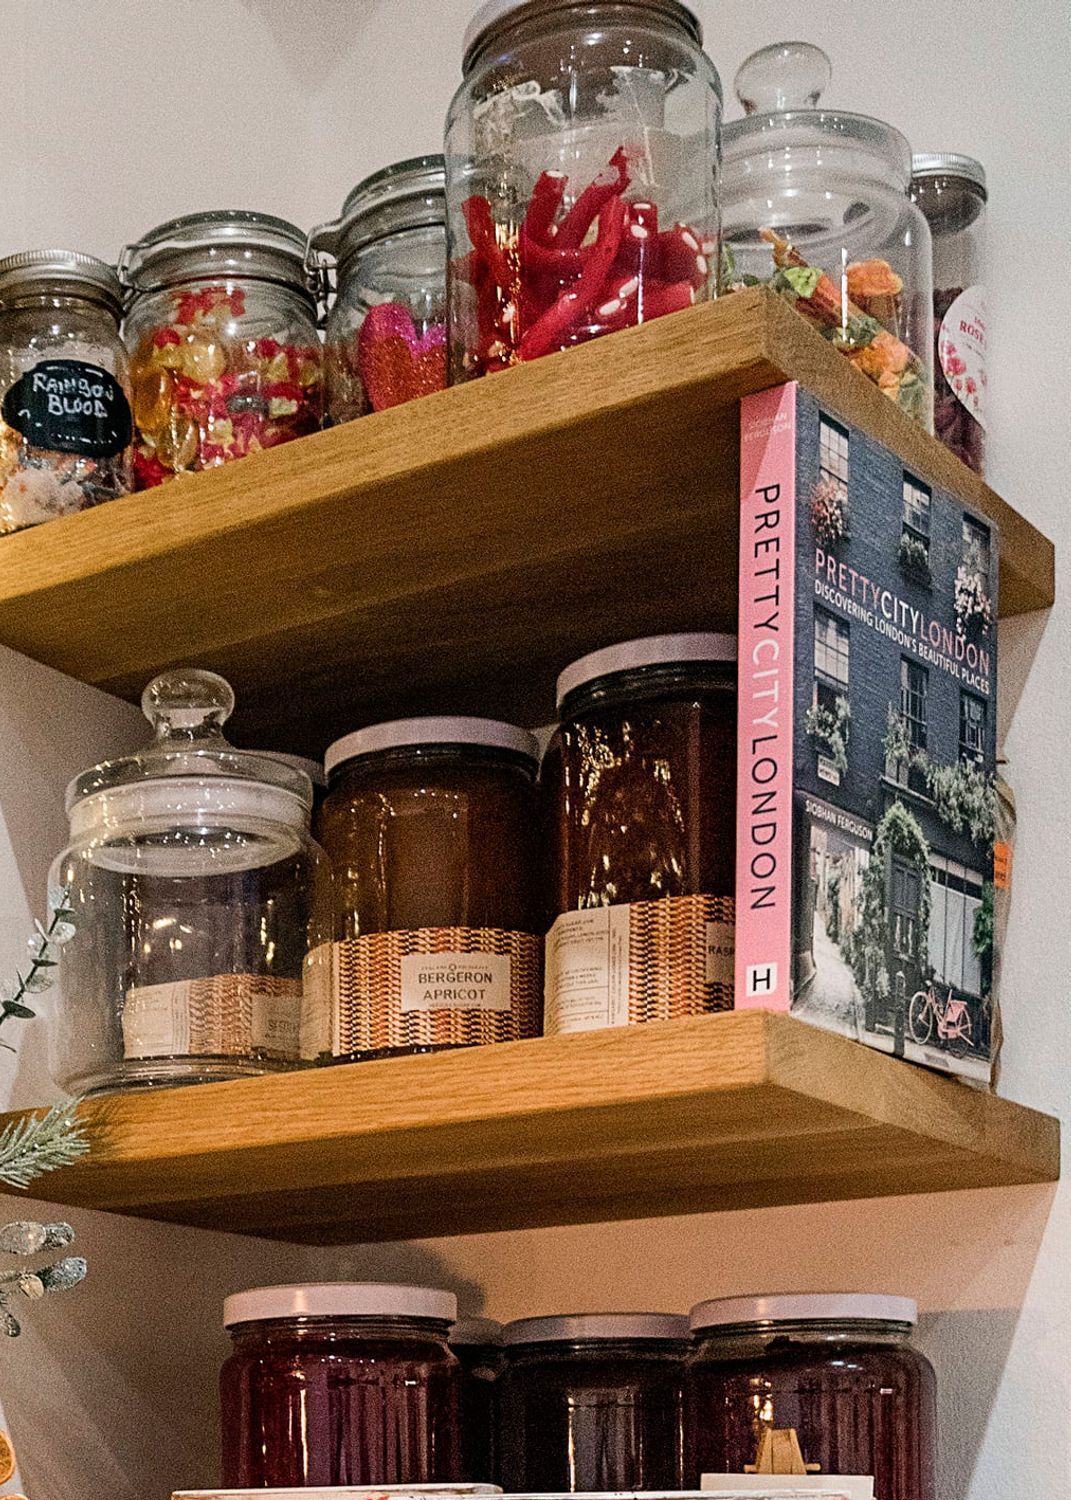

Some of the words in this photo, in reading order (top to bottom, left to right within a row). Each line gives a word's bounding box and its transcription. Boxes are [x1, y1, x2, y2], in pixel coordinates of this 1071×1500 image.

[814, 579, 873, 627] DISCOVERING
[874, 610, 917, 653] LONDON'S
[918, 642, 961, 678] BEAUTIFUL
[961, 667, 990, 695] PLACES
[418, 972, 493, 984] BERGERON
[752, 968, 771, 992] H
[423, 989, 486, 1001] APRICOT
